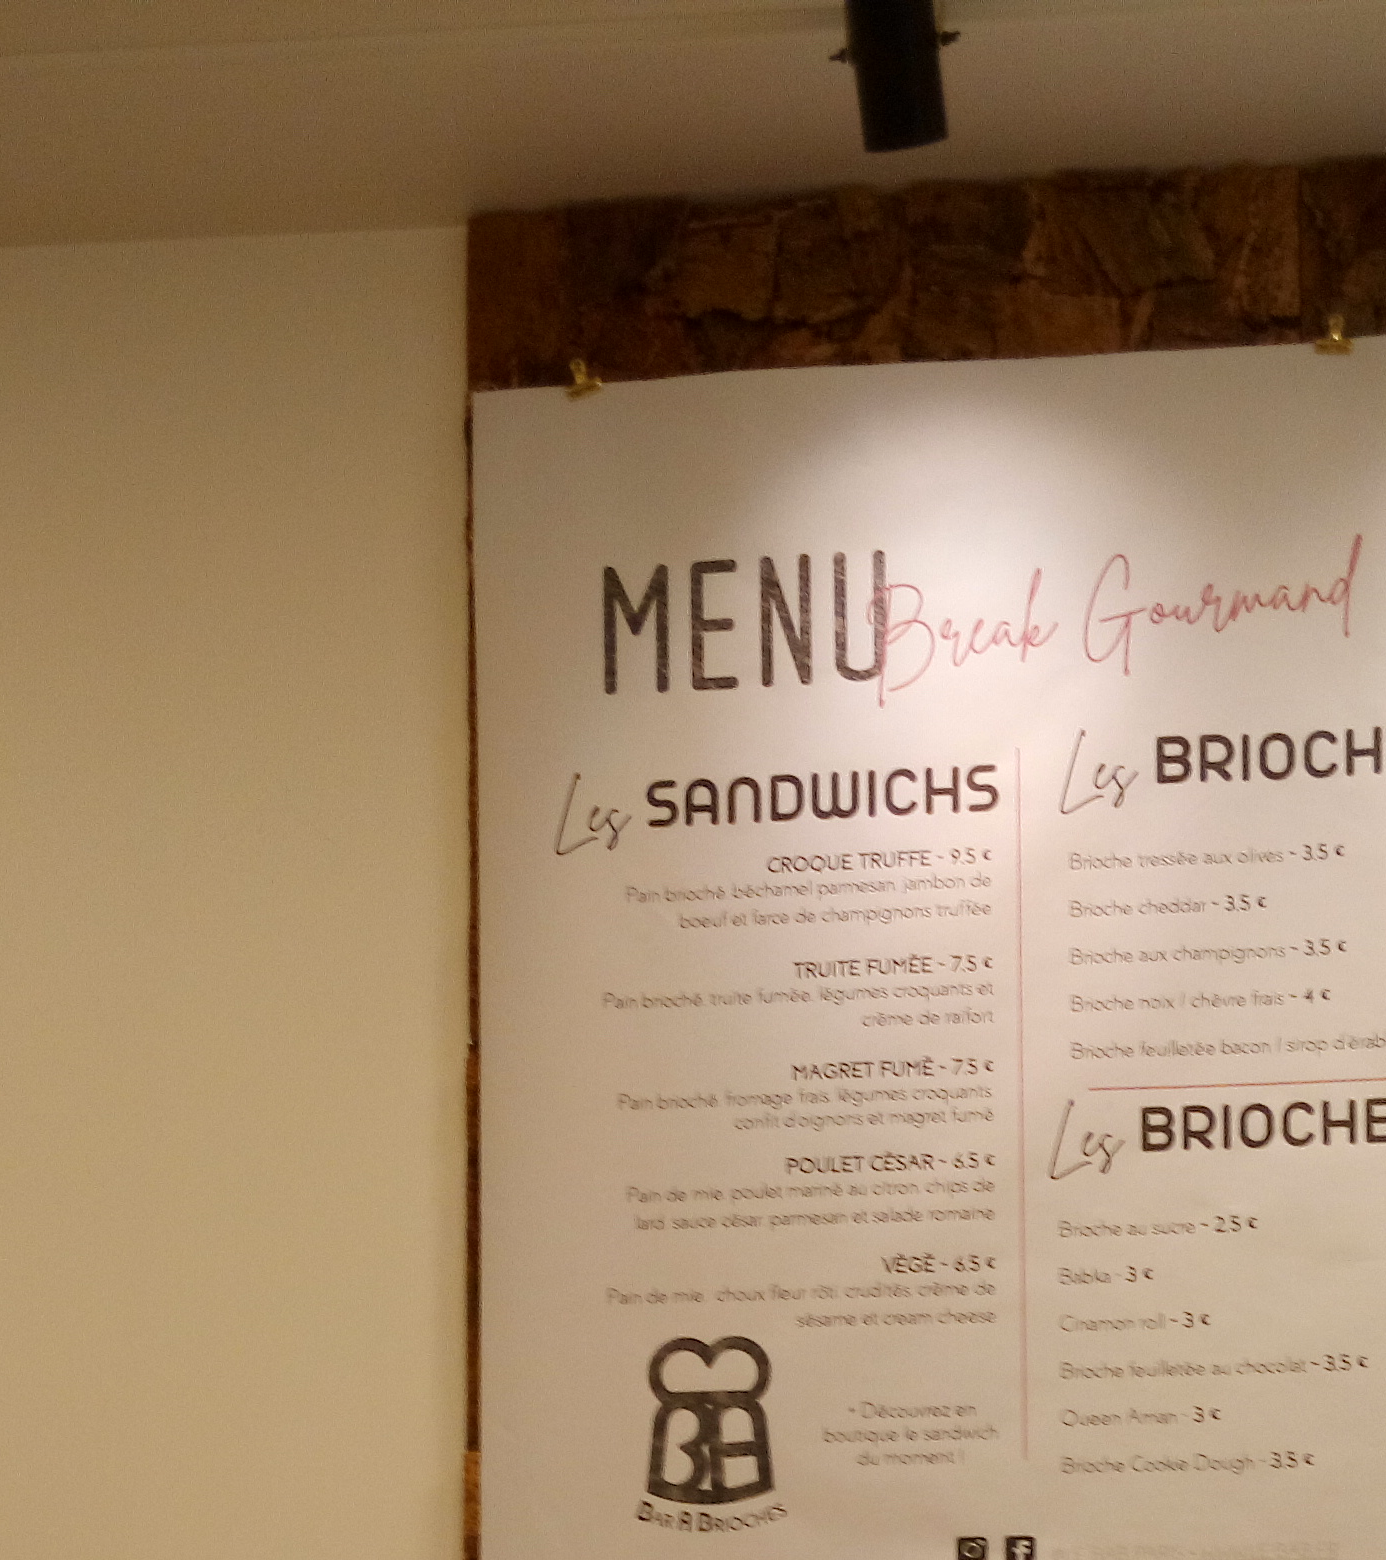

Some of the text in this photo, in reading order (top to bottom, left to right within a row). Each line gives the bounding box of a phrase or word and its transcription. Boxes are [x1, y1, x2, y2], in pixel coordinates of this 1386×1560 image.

[603, 532, 1363, 707] MENU Break Gourmand
[1060, 728, 1140, 815] Les
[555, 764, 999, 855] Les SANDWICHS
[767, 850, 931, 874] CROQUE TRUFFE
[1069, 852, 1133, 871] Brioche
[1203, 851, 1232, 866] aux
[1237, 846, 1284, 865] olives
[817, 879, 896, 899] parmesan
[900, 876, 966, 895] jambon
[970, 873, 992, 889] de
[795, 908, 817, 924] de
[821, 904, 932, 926] champignons
[1069, 899, 1207, 918] Brioche cheddar
[794, 954, 933, 980] TRUITE FUMÉE
[1069, 948, 1134, 967] Brioche
[1139, 949, 1169, 963] aux
[1173, 944, 1286, 967] champignons
[1070, 996, 1134, 1014] Brioche
[1138, 995, 1173, 1010] noix
[1070, 1042, 1134, 1061] Brioche
[1220, 1038, 1272, 1056] bacon
[791, 1056, 935, 1082] MAGRET FUMÉ
[1049, 1100, 1126, 1180] Les
[785, 1152, 935, 1175] POULET CÉSAR
[1058, 1220, 1122, 1239] Brioche
[1126, 1224, 1148, 1237] au
[880, 1253, 935, 1274] VÉGÉ
[1058, 1266, 1138, 1287] Babka 3
[1182, 1312, 1195, 1329] 3
[1059, 1361, 1124, 1381] Brioche
[1192, 1405, 1206, 1423] 3
[1060, 1455, 1125, 1476] Brioche
